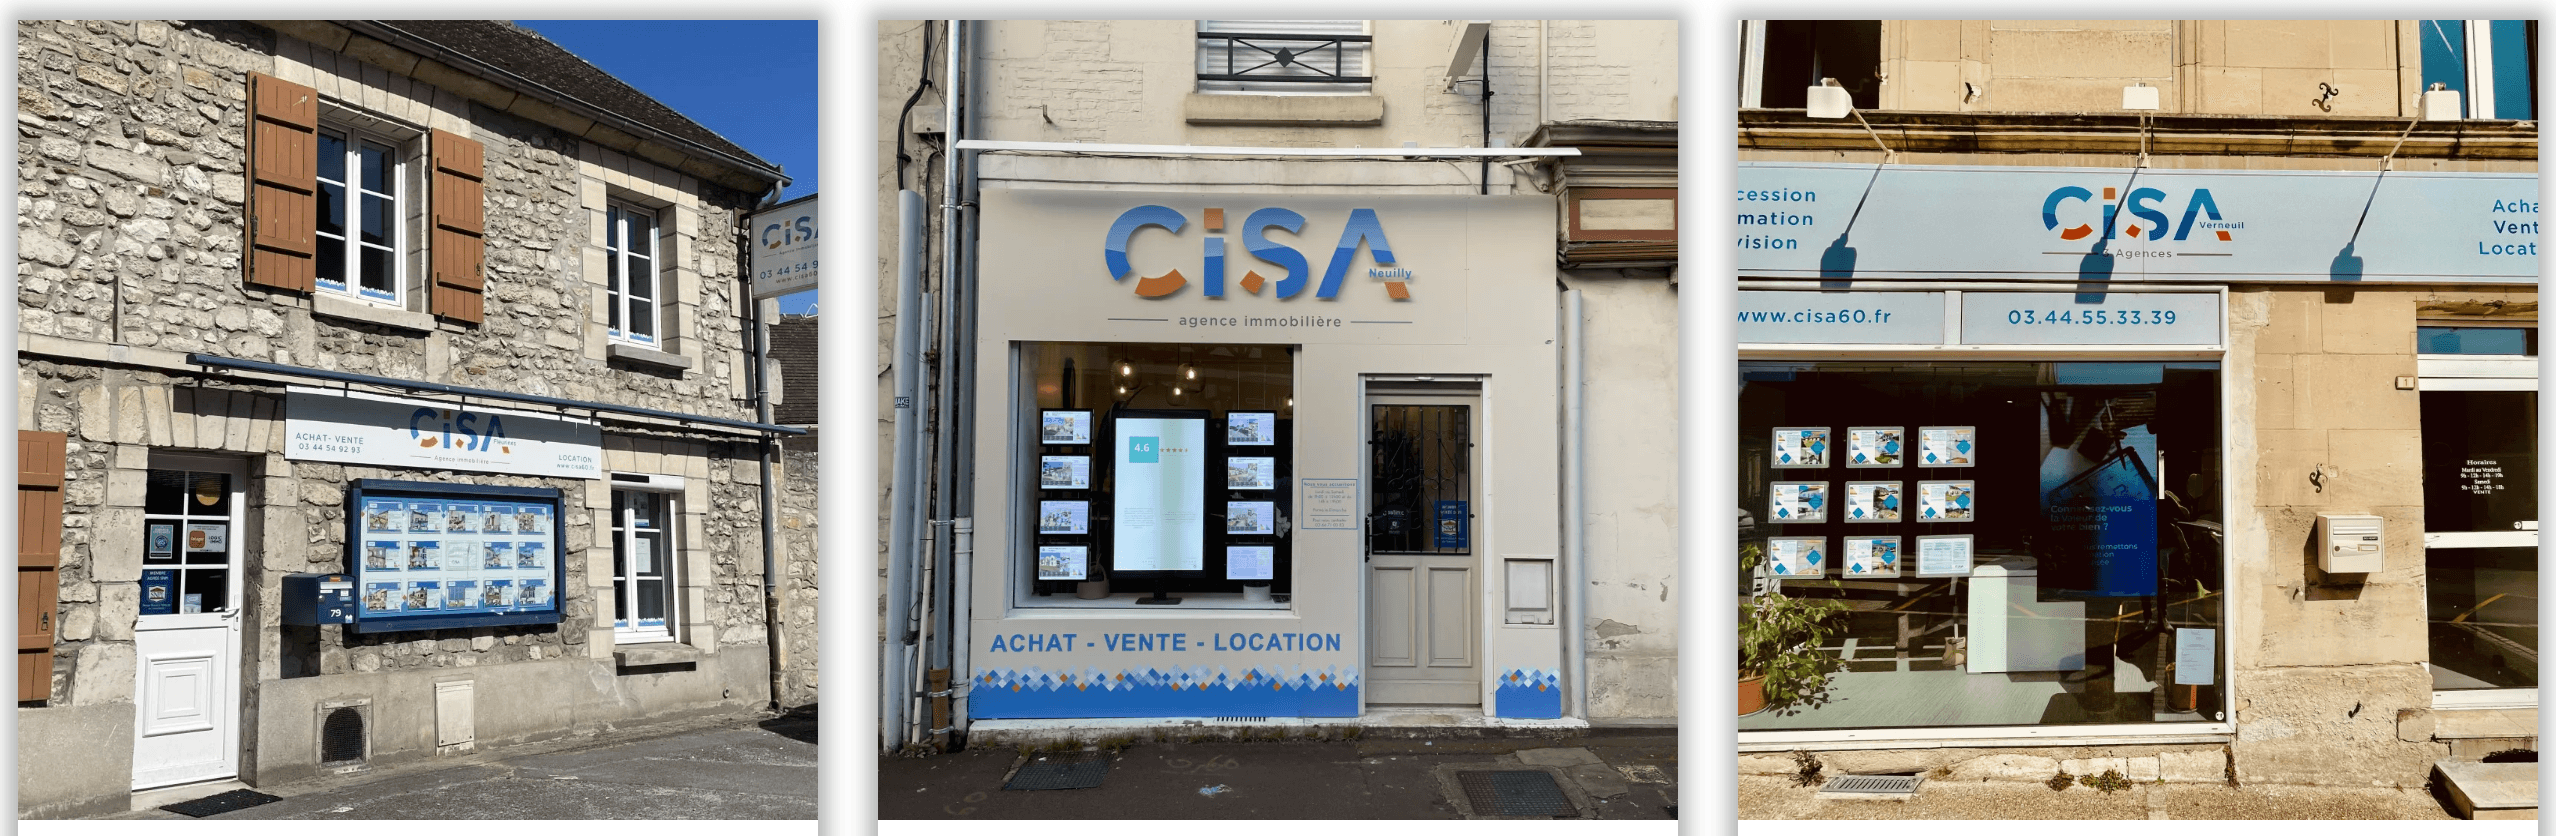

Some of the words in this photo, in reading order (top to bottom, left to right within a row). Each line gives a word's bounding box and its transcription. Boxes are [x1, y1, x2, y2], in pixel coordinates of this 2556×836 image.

[2199, 220, 2244, 230] Verneuil
[2493, 220, 2538, 234] Vent
[762, 216, 818, 249] CiS
[2115, 248, 2172, 260] Agences
[2479, 241, 2537, 256] Locat
[760, 270, 773, 280] 03
[777, 266, 790, 275] 44
[795, 263, 808, 272] 54
[1369, 267, 1413, 280] Neuilly
[1179, 316, 1237, 328] agence
[1244, 315, 1342, 328] immobilière
[1738, 308, 1892, 324] www.cisa60.fr
[2008, 309, 2176, 325] 03.44.55.33.39
[335, 435, 364, 445] VENTE
[299, 443, 310, 451] 03
[326, 444, 336, 452] 54
[351, 446, 361, 454] 93
[1134, 443, 1150, 453] 4.6
[558, 454, 592, 463] LOCATION
[2095, 513, 2108, 522] de
[2079, 522, 2101, 531] bien
[330, 609, 342, 618] 79
[990, 633, 1077, 652] ACHAT
[1104, 633, 1186, 651] VENTE
[1214, 632, 1341, 652] LOCATION
